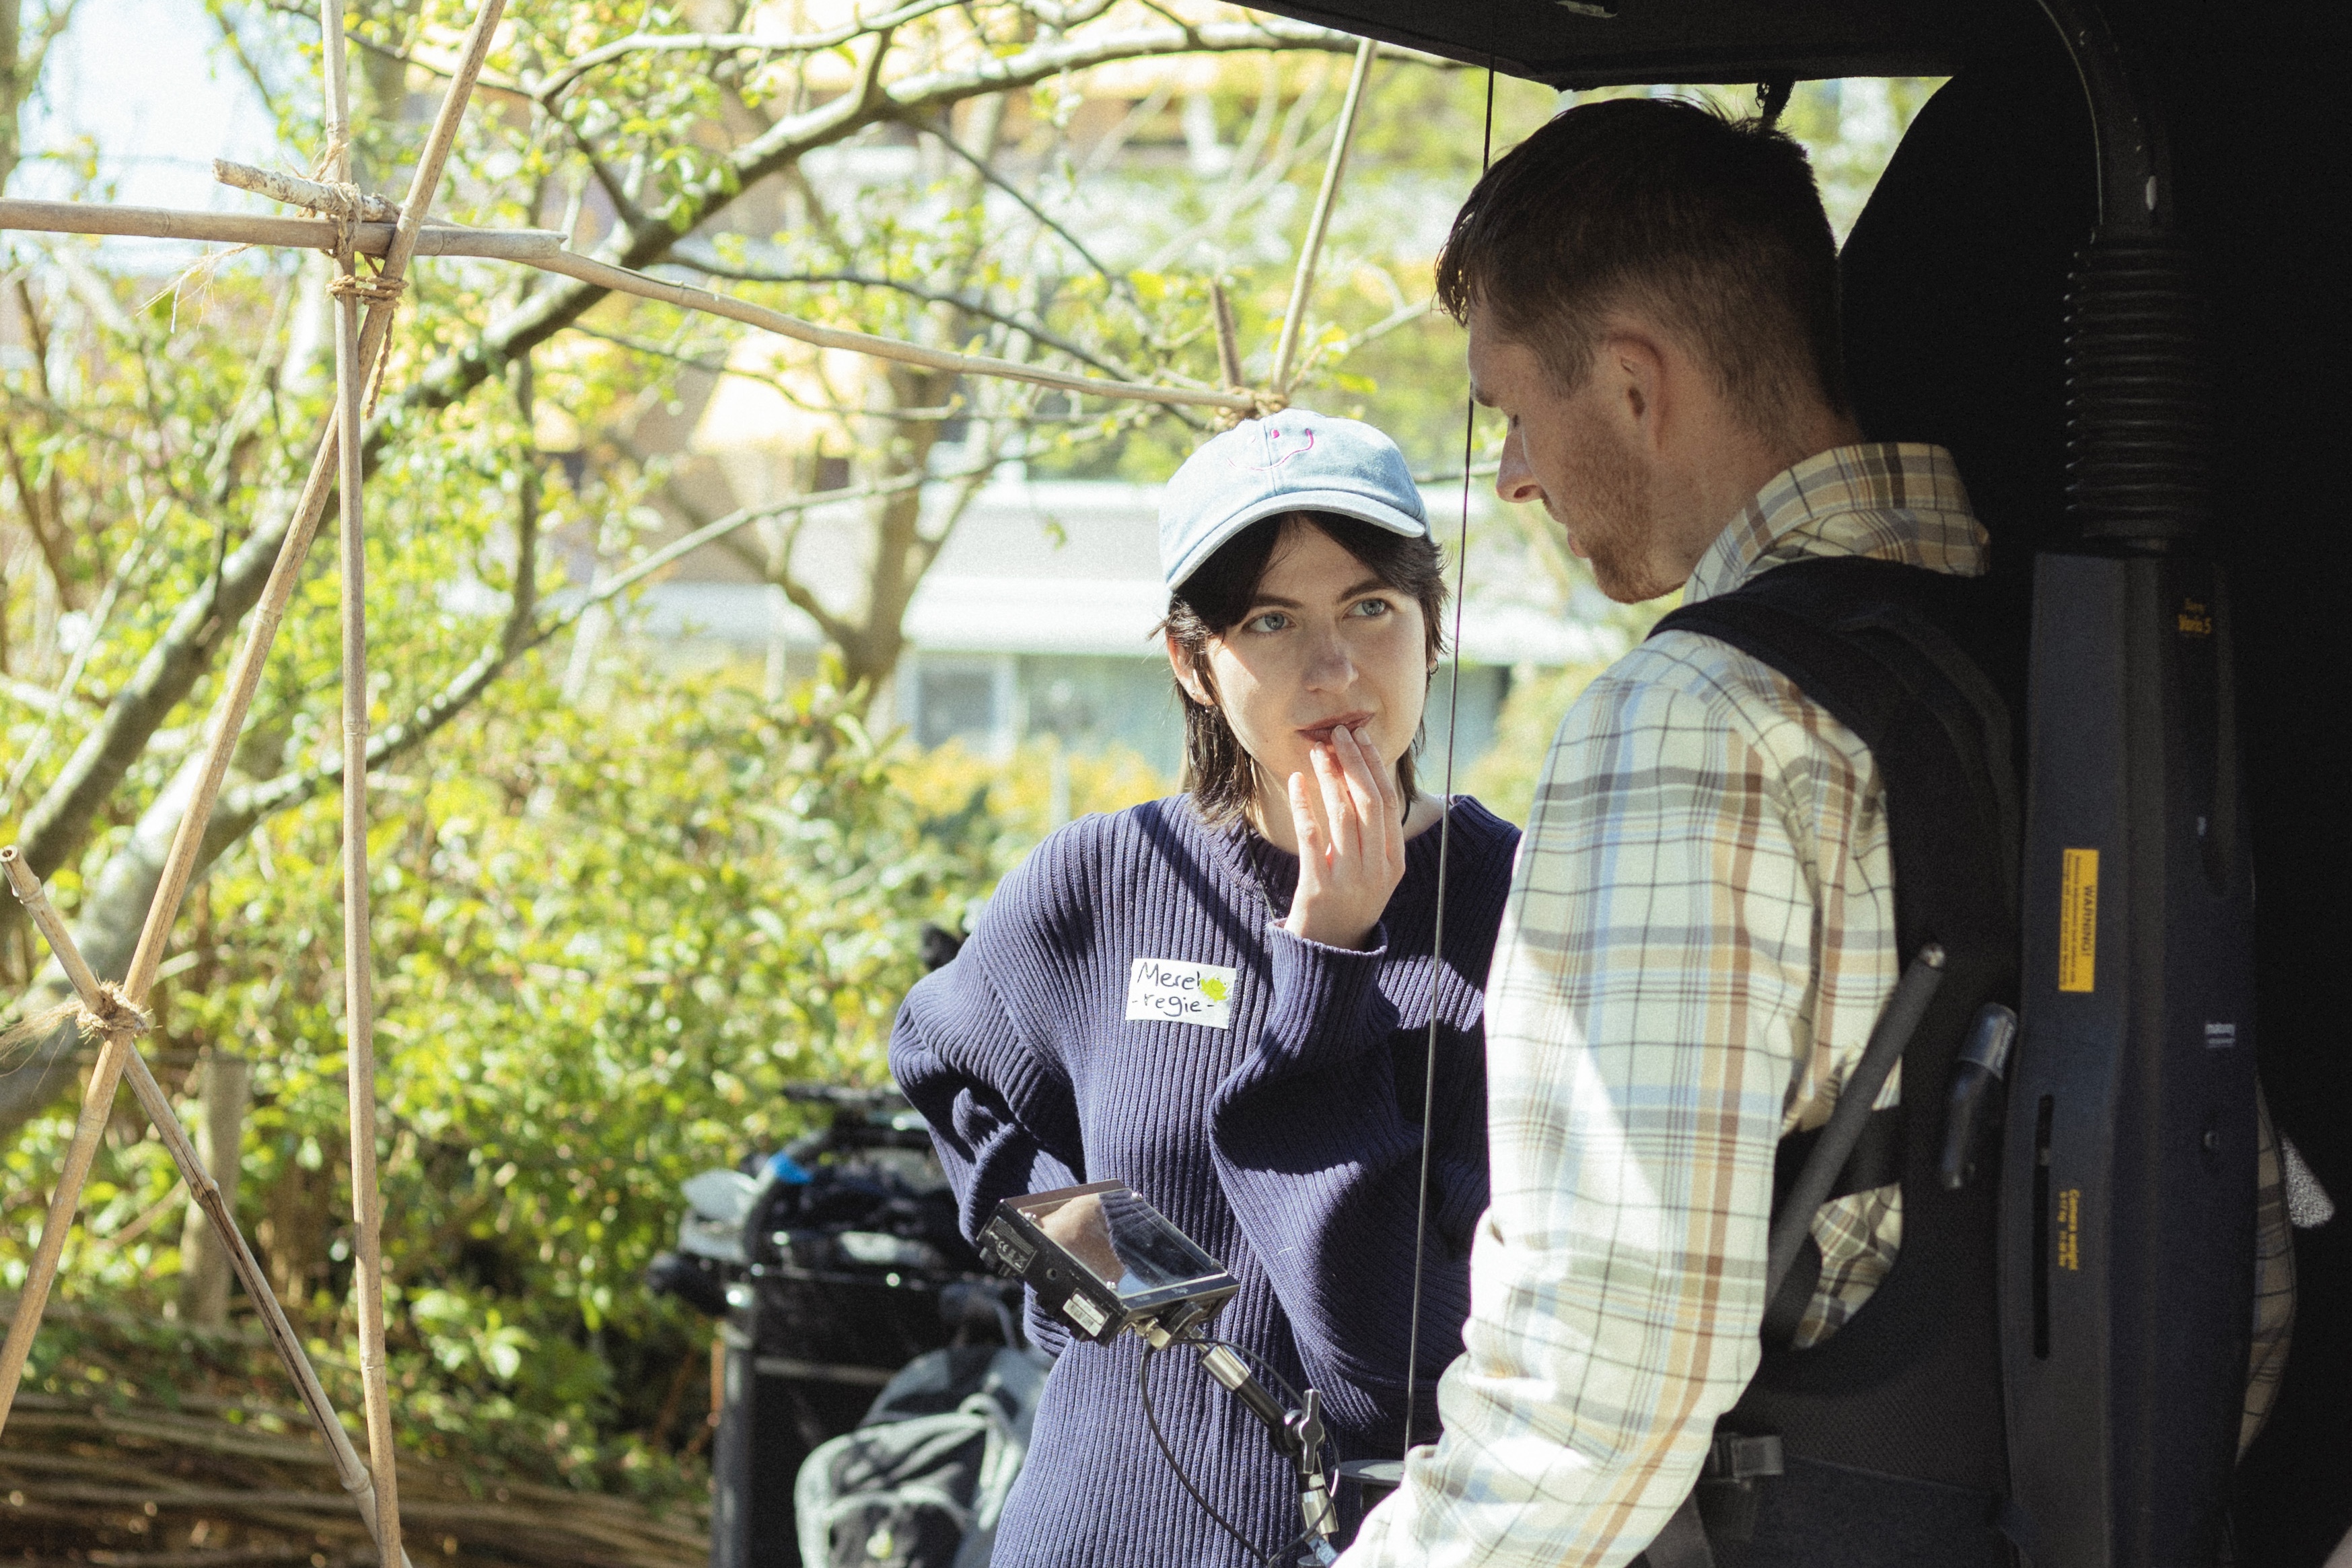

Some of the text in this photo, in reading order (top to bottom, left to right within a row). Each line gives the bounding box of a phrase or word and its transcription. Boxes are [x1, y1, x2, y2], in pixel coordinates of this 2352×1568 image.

[2081, 885, 2093, 956] WARNING!
[1137, 961, 1200, 990] Merel
[2068, 1188, 2079, 1232] Camera
